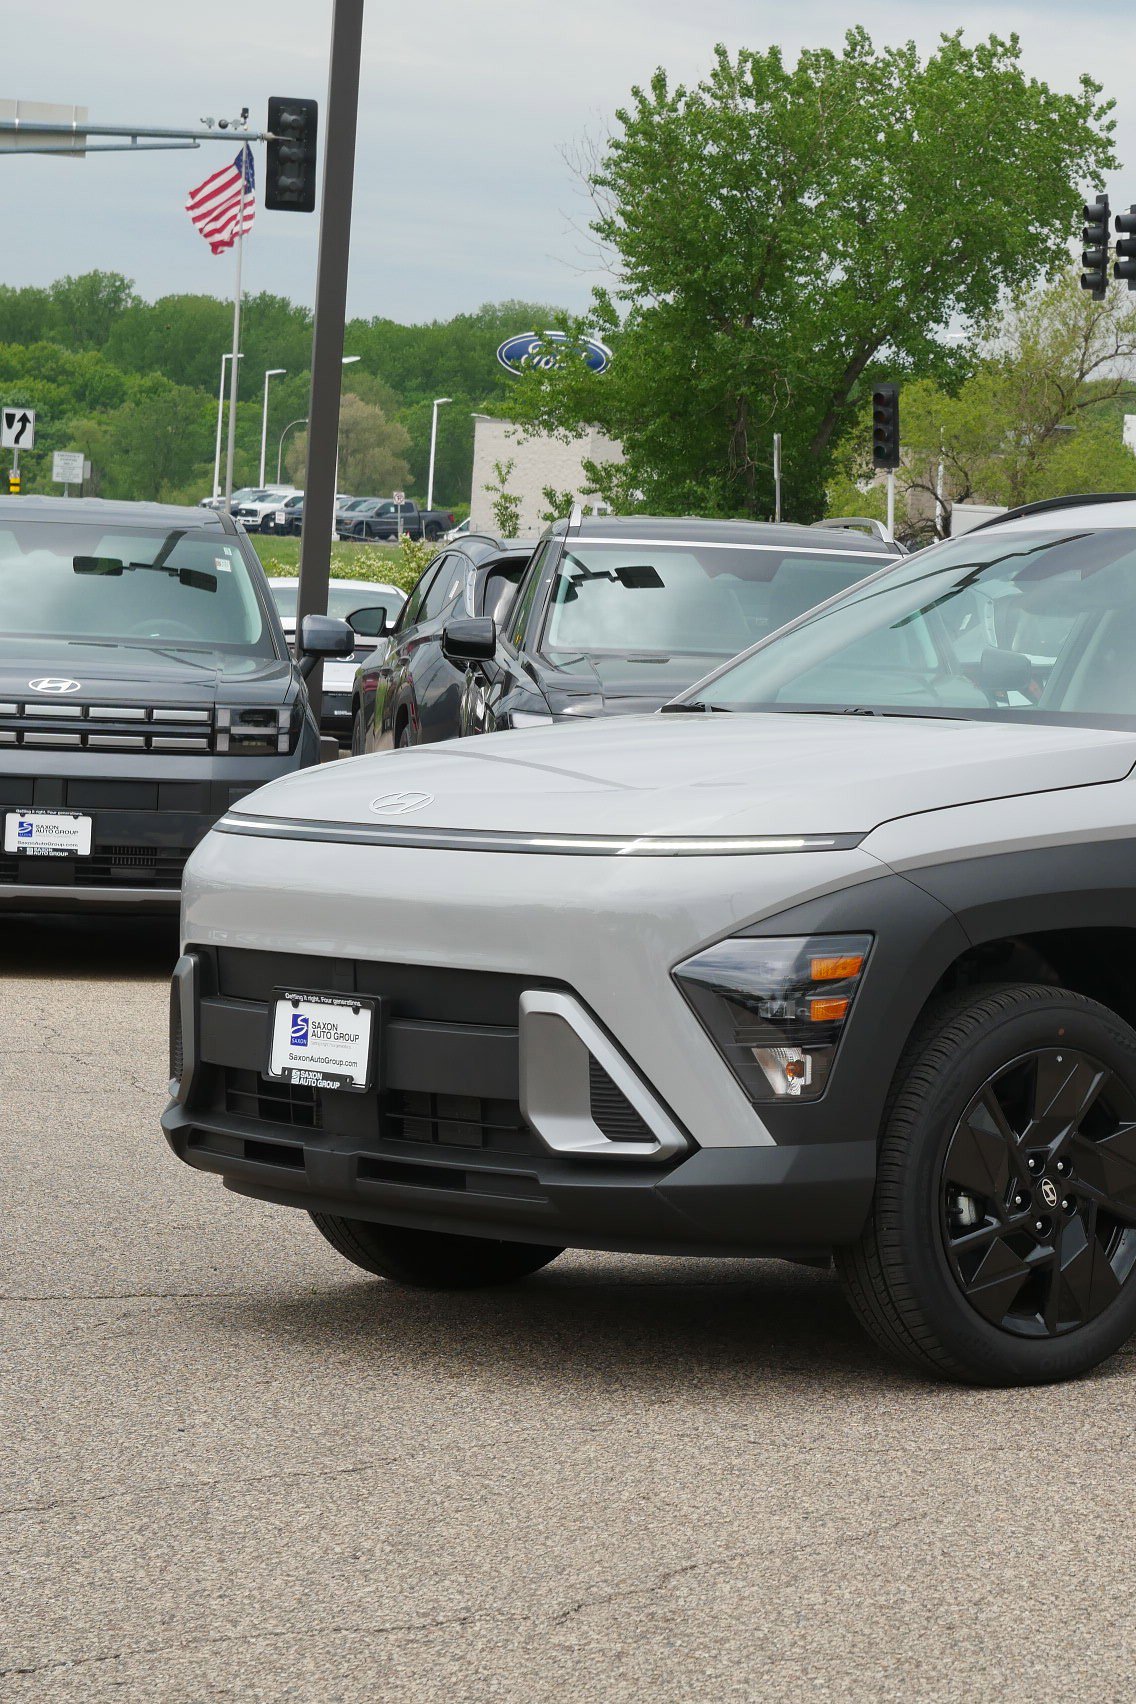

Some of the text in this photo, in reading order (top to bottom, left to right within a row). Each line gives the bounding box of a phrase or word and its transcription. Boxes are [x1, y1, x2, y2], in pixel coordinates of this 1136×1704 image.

[311, 1021, 338, 1031] SAXON
[291, 1037, 307, 1045] SAXON
[310, 1030, 360, 1043] AUTO GROUP
[288, 1052, 358, 1068] SaxonAutoGroup.com
[300, 1070, 323, 1080] SAXON
[299, 1078, 340, 1089] AUTO GROUP
